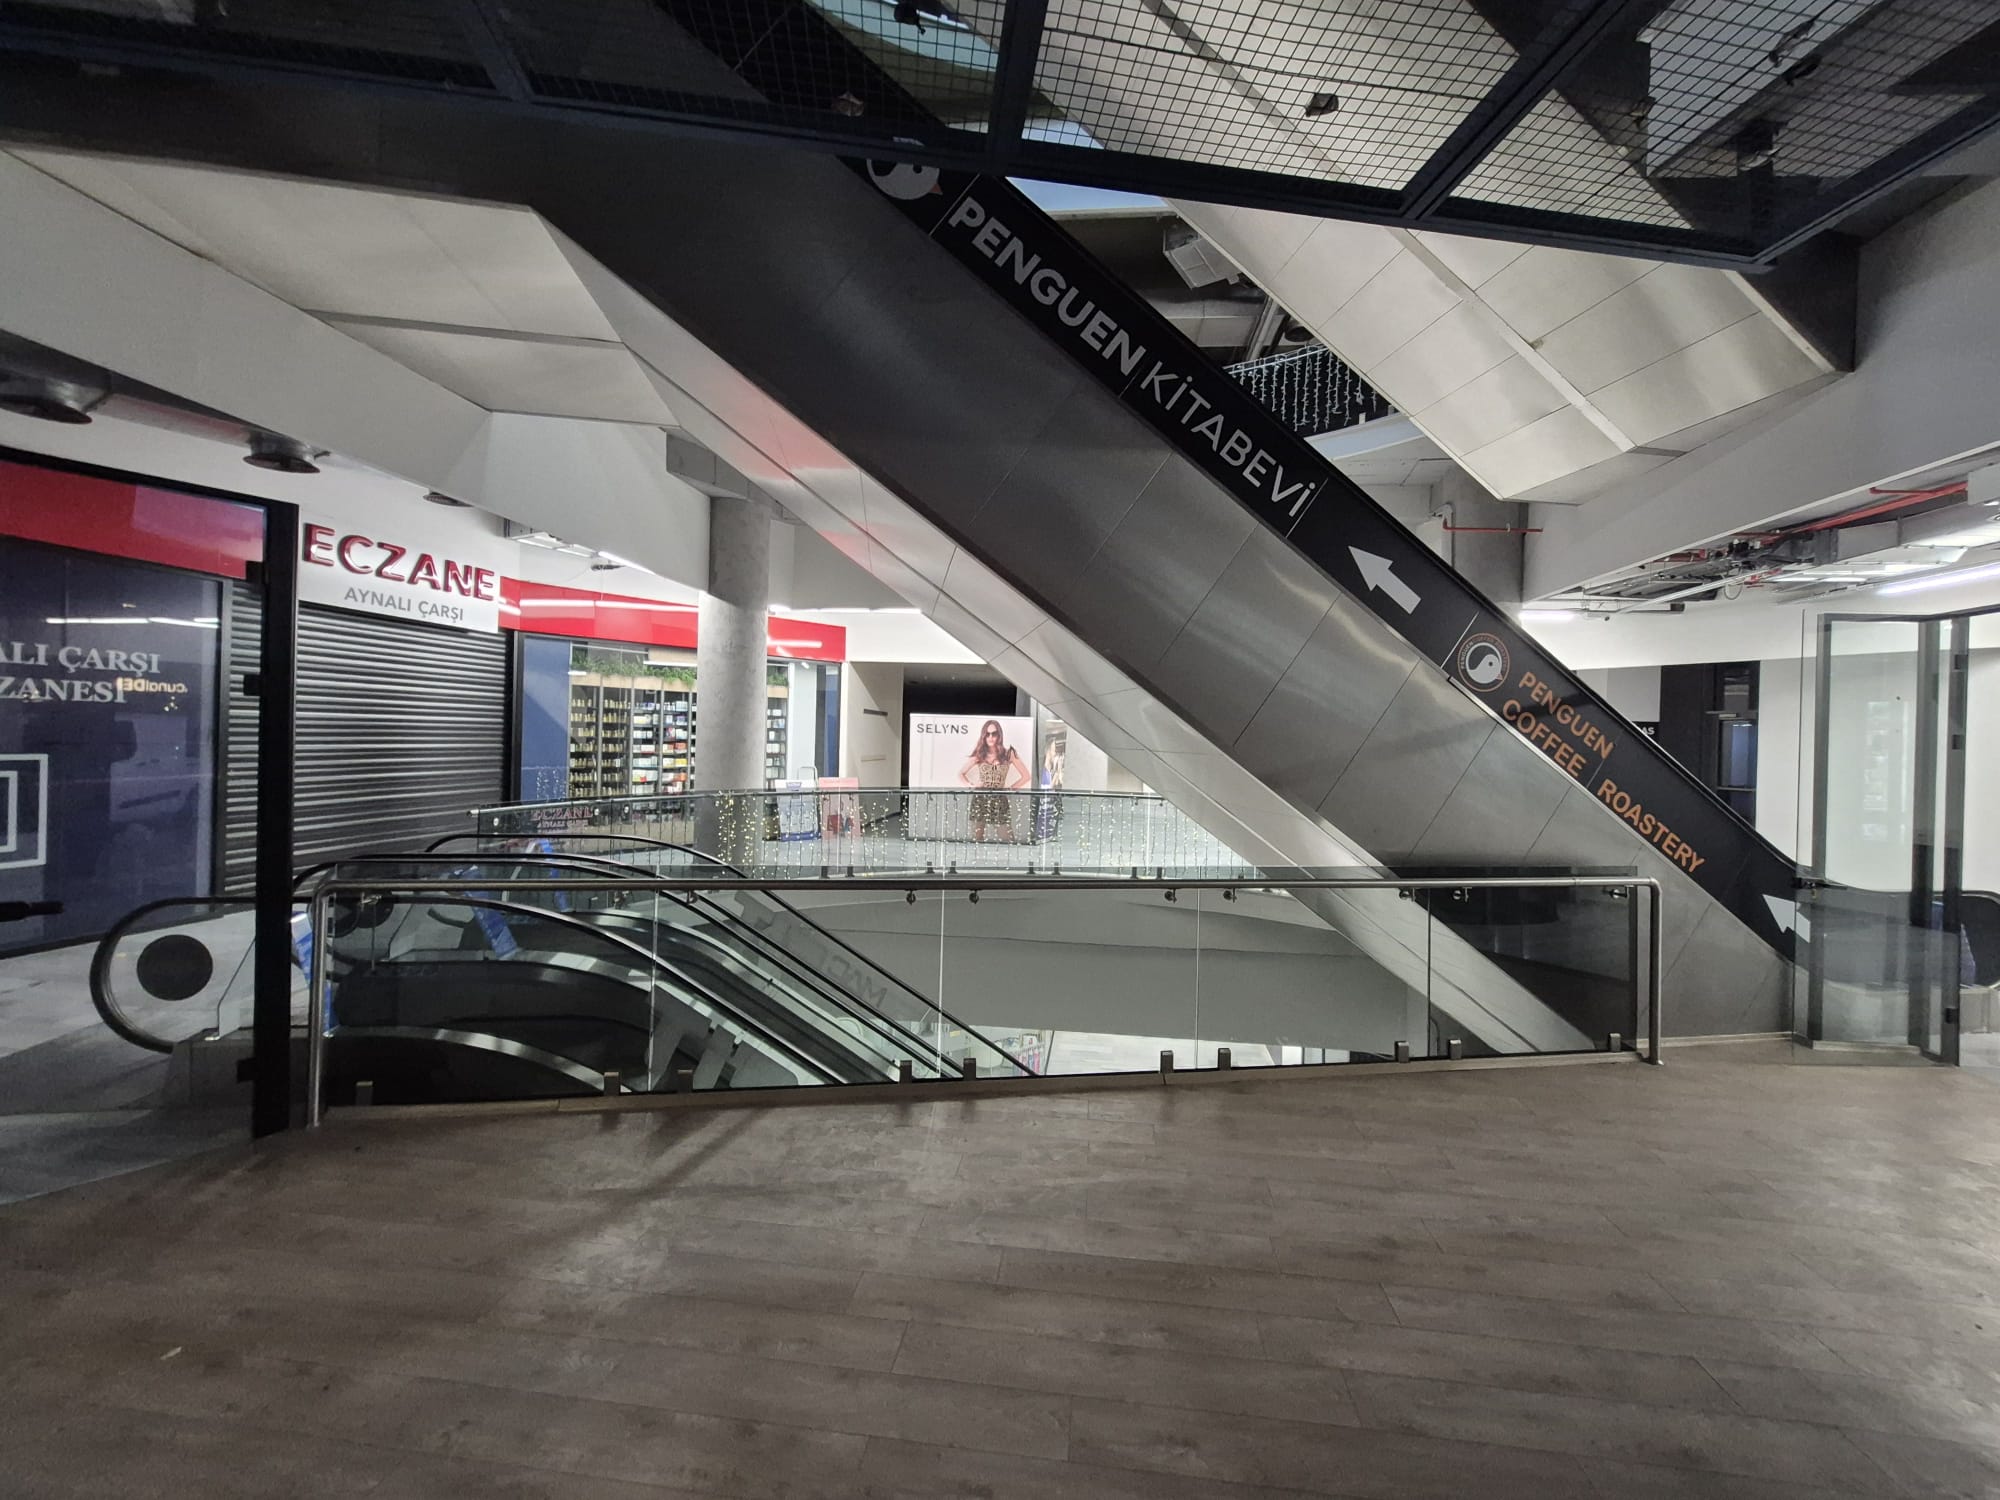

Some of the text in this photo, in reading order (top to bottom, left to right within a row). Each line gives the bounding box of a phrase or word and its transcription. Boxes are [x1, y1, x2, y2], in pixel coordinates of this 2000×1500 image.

[949, 196, 1146, 376] PENGUEN
[303, 522, 495, 600] ECZANE
[344, 587, 464, 623] AYNALI ÇARŞI
[58, 646, 160, 677] ÇARŞI
[916, 723, 969, 735] SELYNS
[1519, 671, 1615, 759] PENGUEN
[1502, 699, 1705, 873] COFFEE ROASTERY
